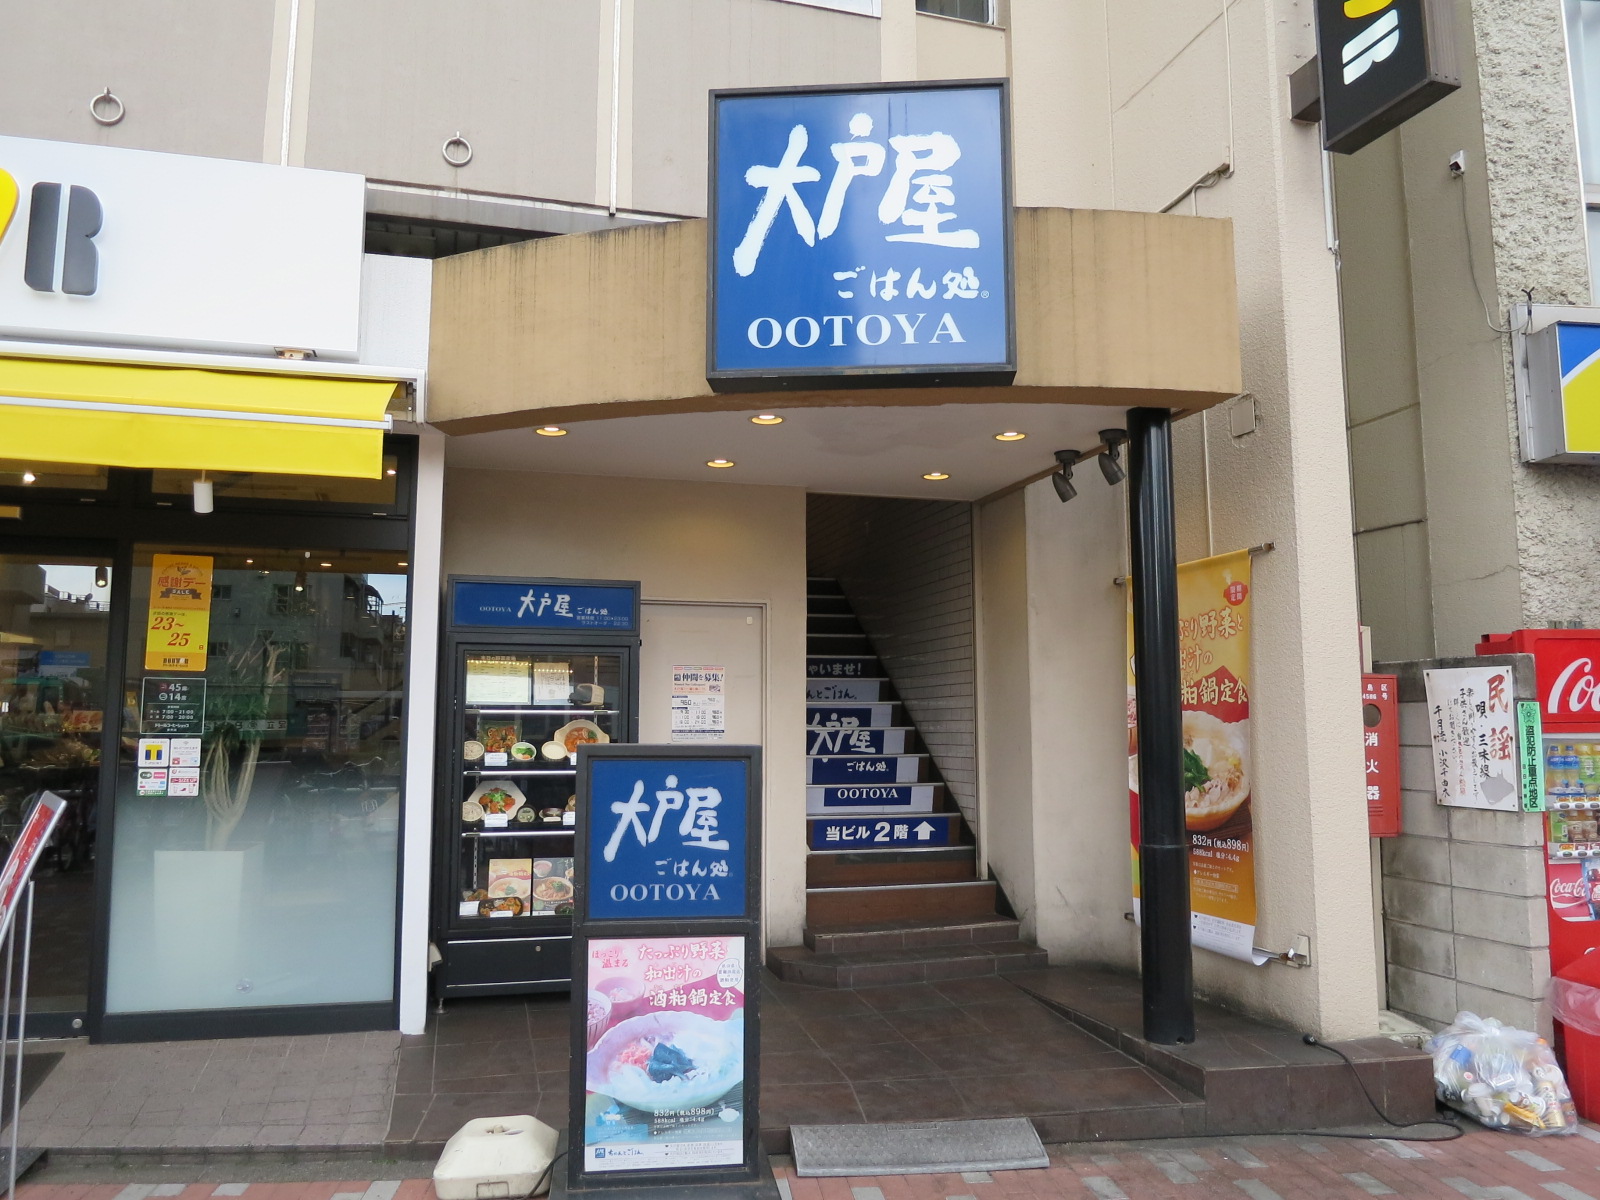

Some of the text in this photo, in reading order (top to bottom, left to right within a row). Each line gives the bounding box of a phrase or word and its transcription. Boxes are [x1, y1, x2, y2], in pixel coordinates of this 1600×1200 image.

[733, 112, 980, 277] 大戸屋
[833, 266, 980, 300] ごはん処
[747, 312, 967, 349] OOTOYA
[518, 588, 573, 618] 大戸屋
[577, 607, 608, 616] ごはん処
[168, 633, 190, 646] 25
[1487, 674, 1512, 760] 民謡
[847, 761, 888, 772] ごはん処
[838, 788, 898, 799] OOTOYA
[604, 774, 730, 862] 大戸屋
[826, 822, 909, 841] 当ビル2階
[655, 858, 728, 877] ごはん処
[610, 884, 720, 901] OOTOYA
[649, 988, 737, 1007] 酒粕鍋定食
